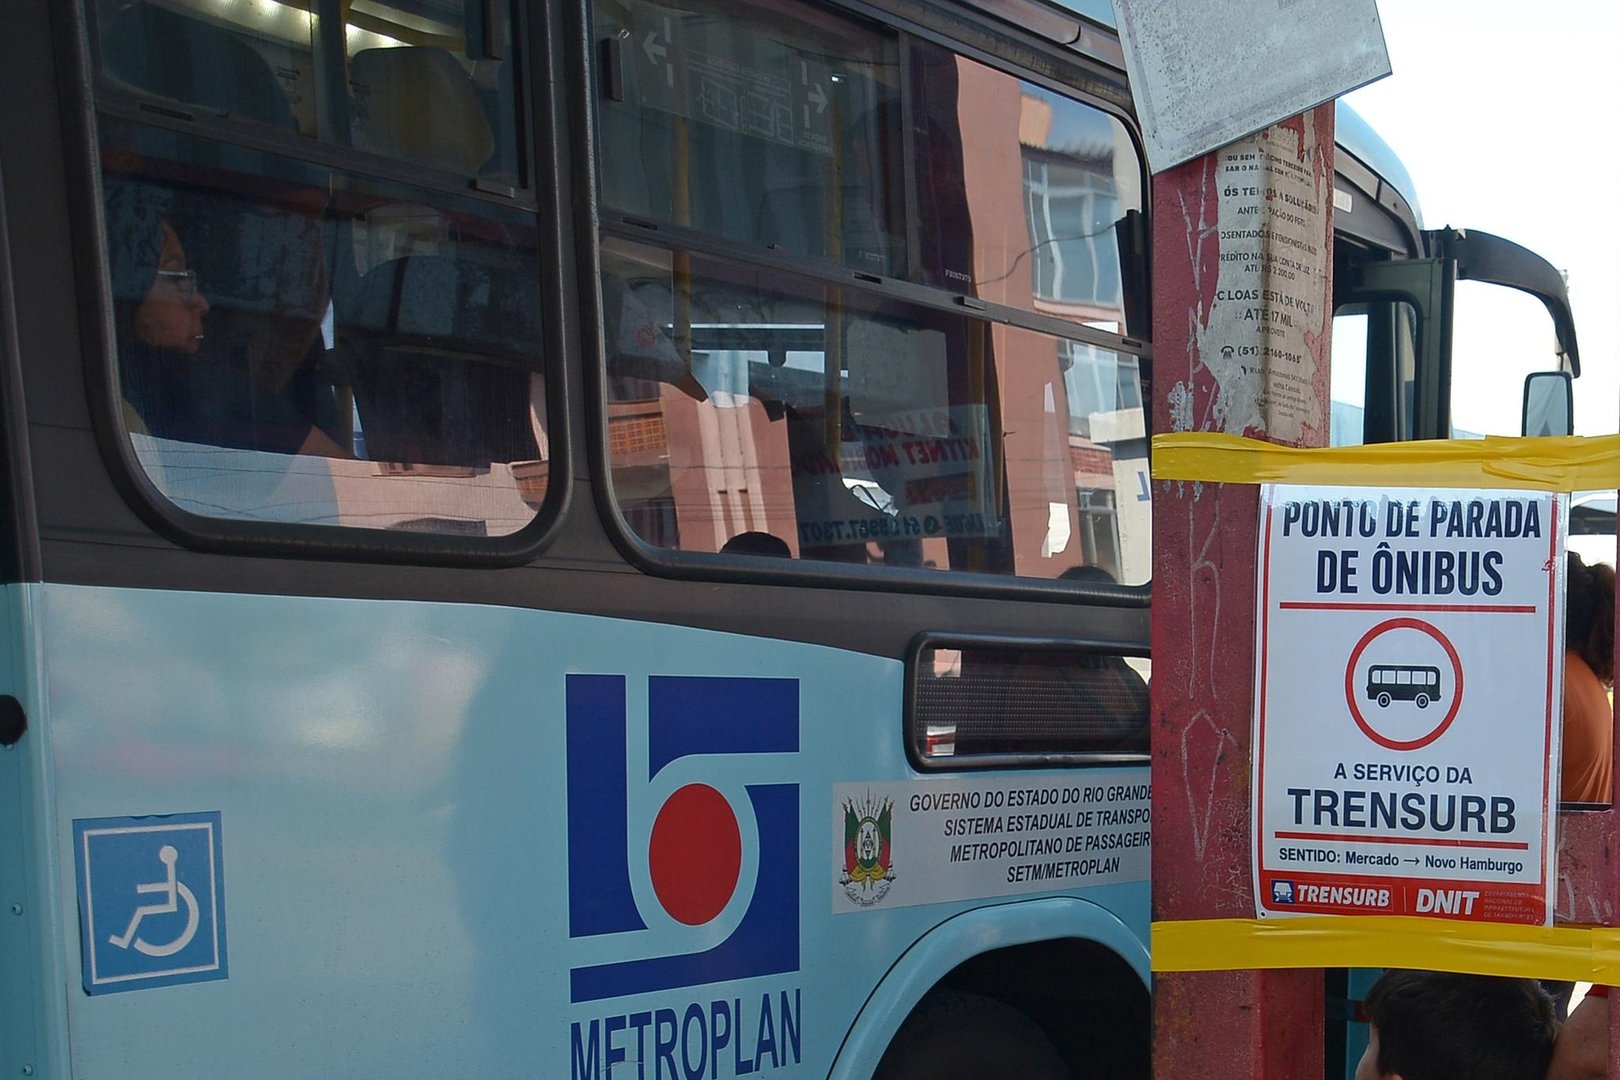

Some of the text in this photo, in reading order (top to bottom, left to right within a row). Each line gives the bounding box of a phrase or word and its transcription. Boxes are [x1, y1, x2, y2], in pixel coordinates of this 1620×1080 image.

[1240, 153, 1256, 161] SEM
[1251, 253, 1263, 261] NA
[1228, 290, 1259, 300] LOAS
[1263, 289, 1284, 304] ESTÁ
[1284, 295, 1295, 307] DE
[1244, 306, 1269, 321] ATÉ
[1270, 310, 1279, 322] 17
[1238, 346, 1259, 357] (51)
[1283, 499, 1541, 539] PONTO DE PARADA
[1317, 542, 1503, 596] DE ÔNIBUS
[1334, 764, 1473, 788] A SERVIÇO DA
[910, 792, 981, 812] GOVERNO
[984, 790, 1004, 808] DO
[1007, 788, 1059, 807] ESTADO
[1062, 787, 1080, 804] DO
[1083, 786, 1104, 803] RIO
[1287, 788, 1517, 835] TRENSURB
[944, 808, 1151, 836] SISTEMA ESTADUAL DE TRANSPO
[950, 831, 1151, 862] METROPOLITANO DE PASSAGEIR
[1007, 857, 1120, 882] SETM/METROPLAN
[1279, 847, 1524, 875] SENTIDO: Mercado Novo Hamburgo
[1297, 884, 1480, 915] TRENSURB DNIT
